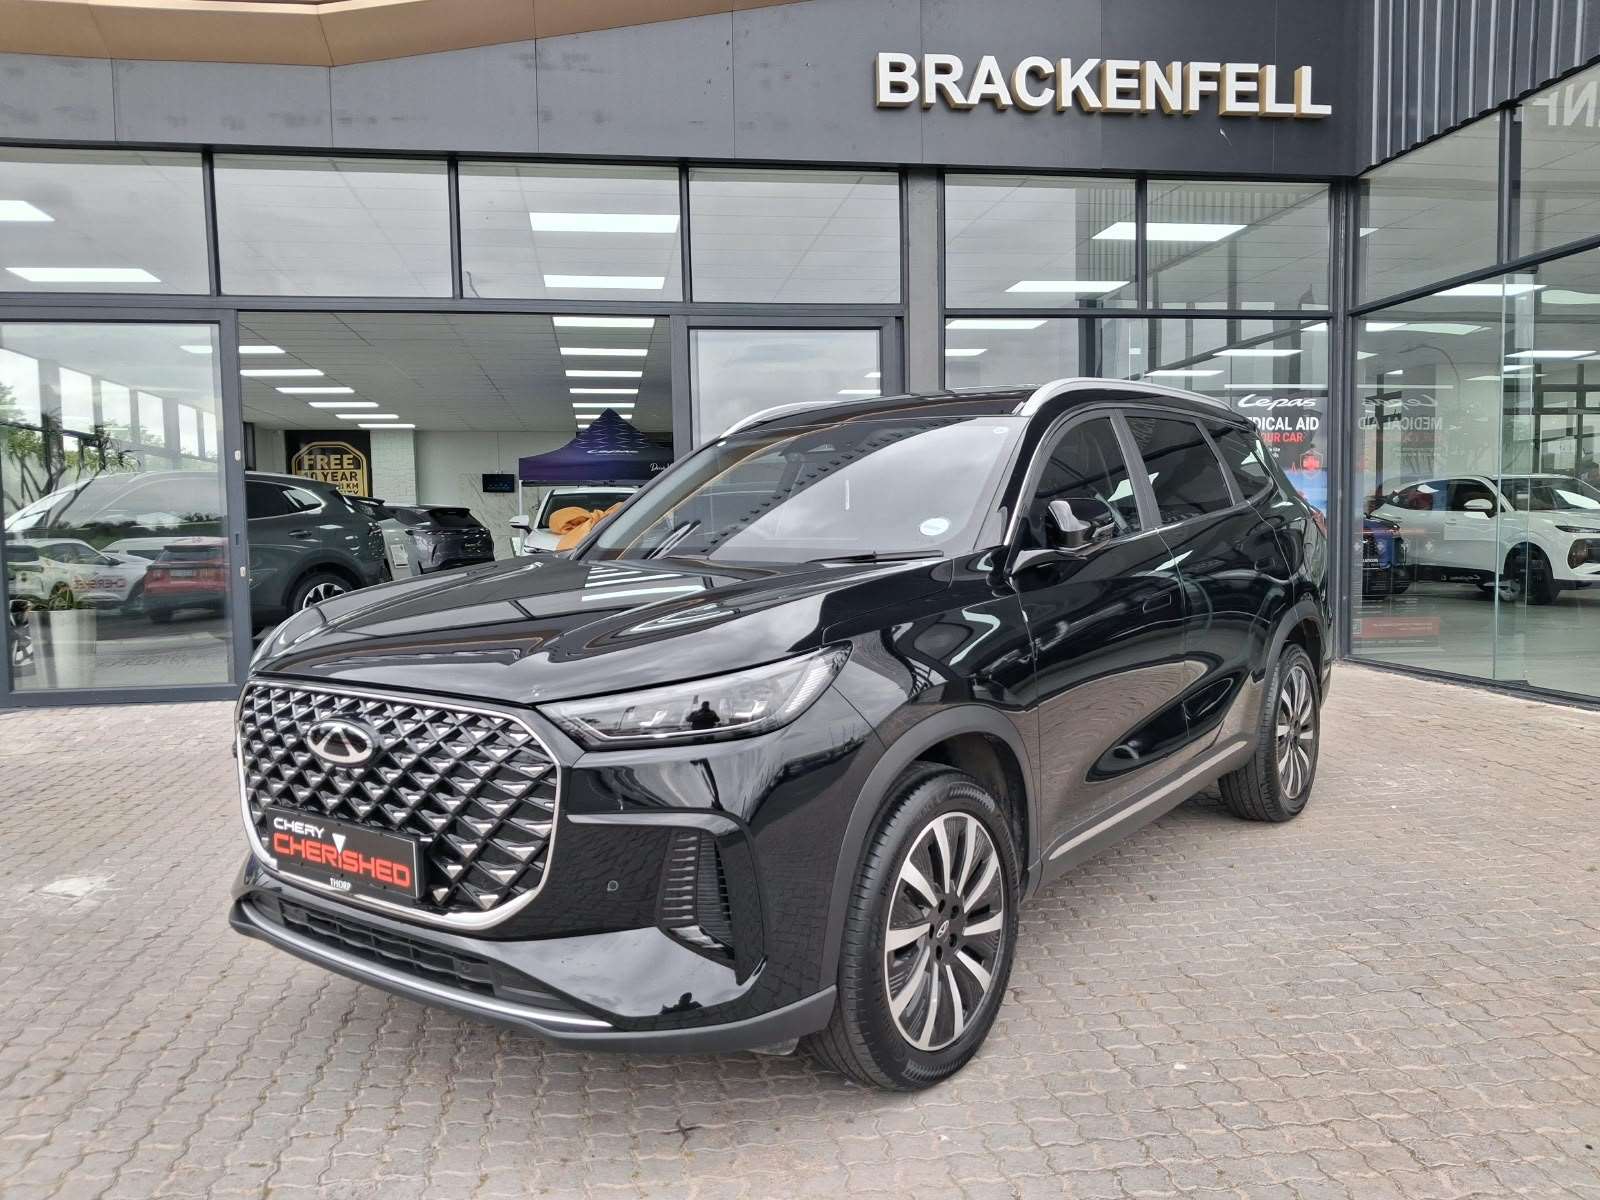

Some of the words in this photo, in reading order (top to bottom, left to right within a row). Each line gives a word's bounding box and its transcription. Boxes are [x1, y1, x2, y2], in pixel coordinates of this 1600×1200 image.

[876, 52, 1333, 118] BRACKENFELL
[1238, 393, 1317, 411] Lepas
[1247, 416, 1293, 431] DICAL
[1296, 416, 1320, 431] AID
[1259, 432, 1280, 443] OUR
[1282, 432, 1304, 443] CAR
[303, 454, 354, 469] FREE
[320, 471, 358, 482] YEAR
[273, 817, 325, 839] CHERY
[273, 832, 411, 888] CHERISHED
